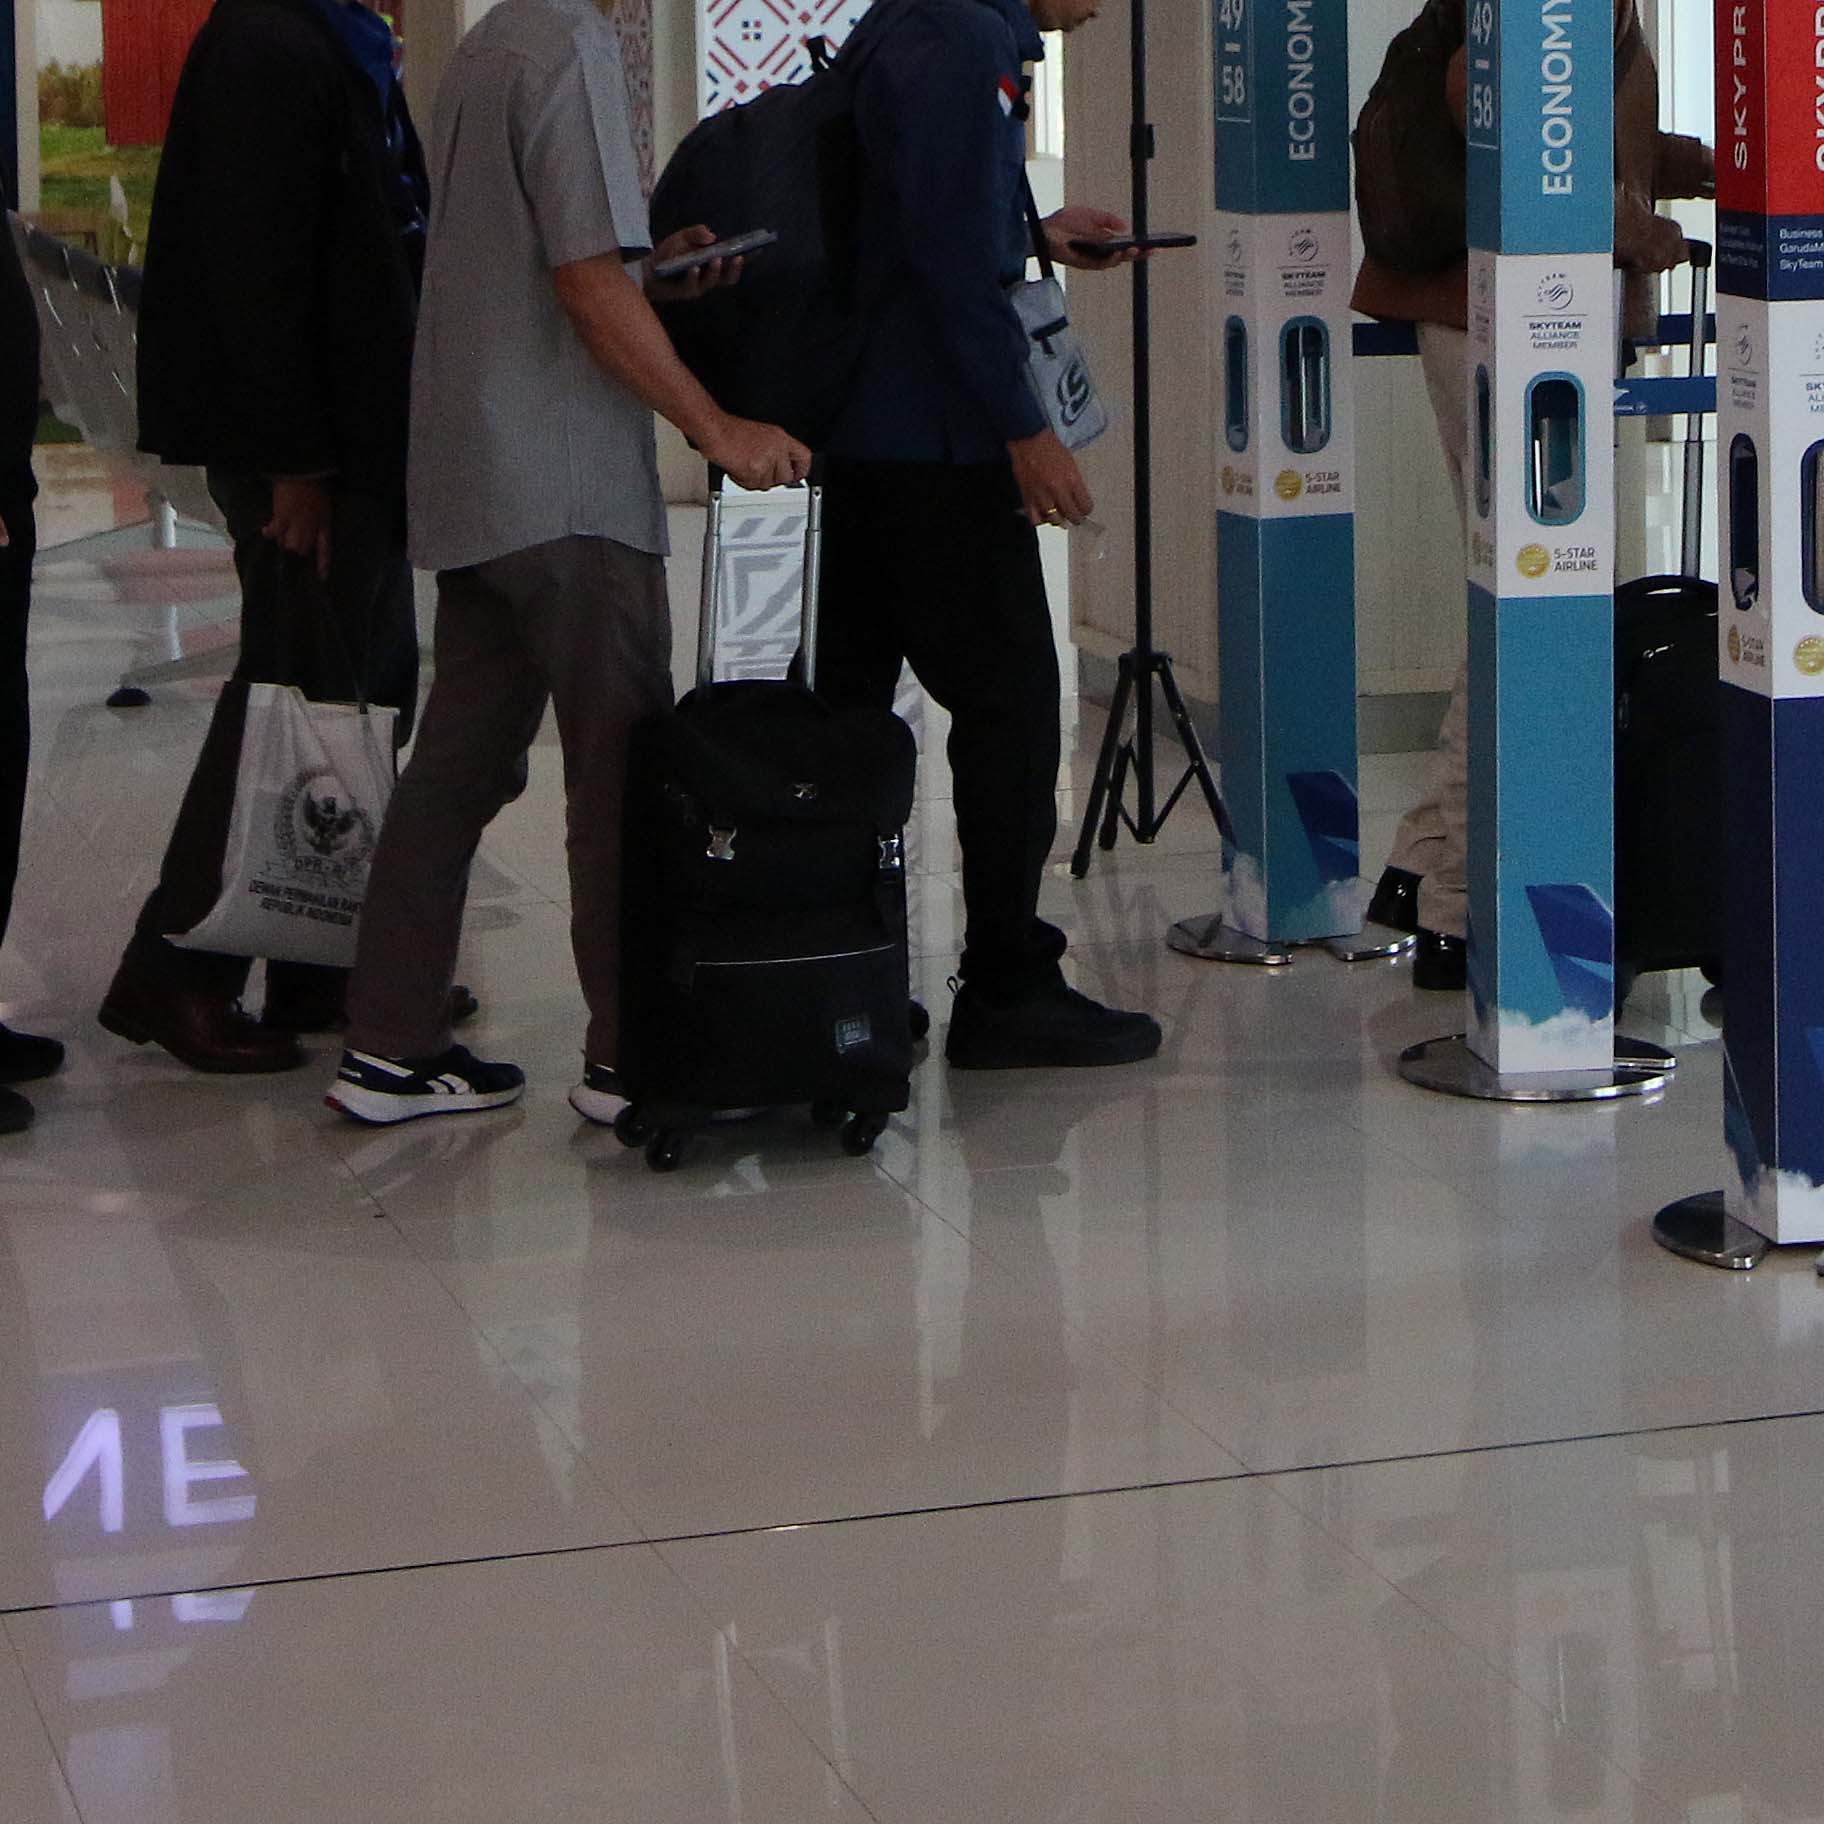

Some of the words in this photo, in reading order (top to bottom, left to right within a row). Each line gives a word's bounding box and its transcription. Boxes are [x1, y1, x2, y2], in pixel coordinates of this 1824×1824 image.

[1471, 2, 1493, 46] 49
[1222, 66, 1245, 106] 58
[1473, 83, 1493, 130] 58
[1779, 228, 1823, 240] Business
[1779, 259, 1824, 273] SkyTeam
[1528, 320, 1582, 331] SKYTEAM
[1530, 331, 1581, 341] ALLIANCE
[1553, 547, 1596, 560] 5-STAR
[1554, 560, 1599, 572] AIRLINE
